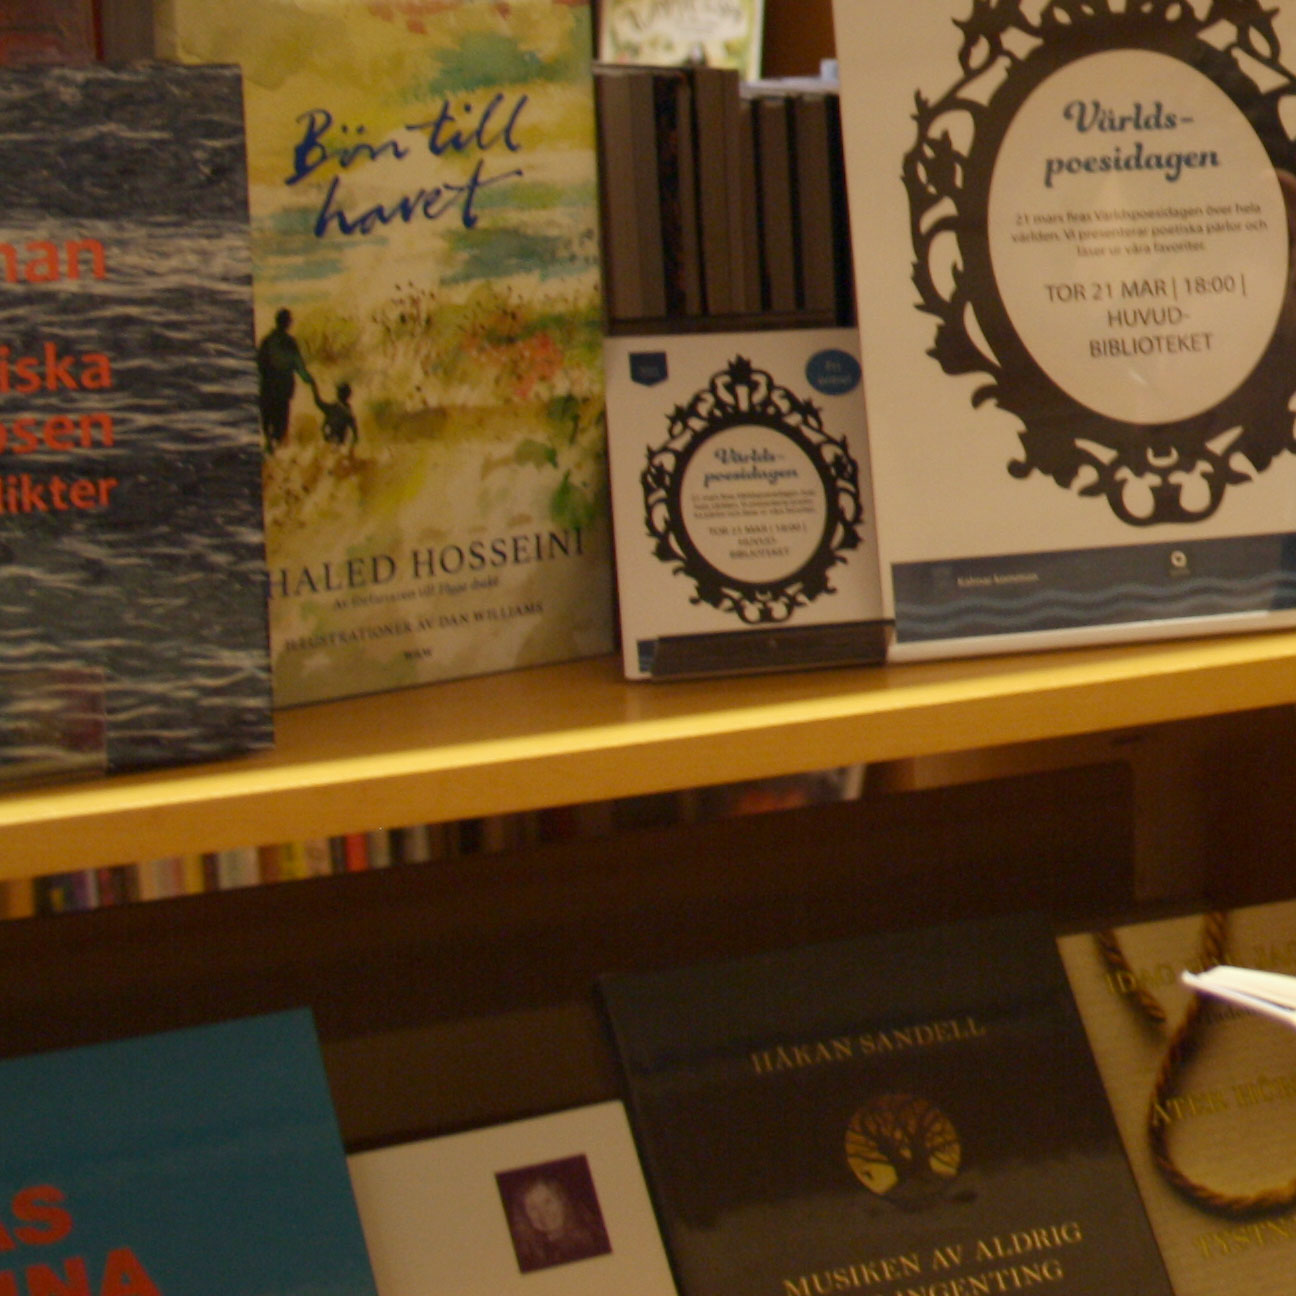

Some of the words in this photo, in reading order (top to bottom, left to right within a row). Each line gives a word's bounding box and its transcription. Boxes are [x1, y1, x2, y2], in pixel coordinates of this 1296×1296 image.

[1063, 100, 1194, 134] Världs-
[285, 109, 409, 186] Bön
[405, 93, 528, 155] till
[1044, 141, 1219, 189] poesidagen
[314, 158, 523, 237] havet
[1044, 282, 1087, 304] TOR
[1091, 280, 1113, 301] 21
[1121, 278, 1168, 301] MAR
[1184, 275, 1236, 298] 18:00
[1107, 306, 1191, 329] HUVUD-
[1089, 332, 1214, 359] BIBLIOTEKET
[0, 412, 115, 454] sen
[0, 474, 118, 515] ikter
[268, 554, 395, 598] HALED
[413, 527, 585, 579] HOSSEINI
[438, 611, 470, 630] DAN
[858, 1016, 986, 1055] SANDELL
[782, 1252, 922, 1296] MUSIKEN
[931, 1244, 963, 1271] AV
[975, 1221, 1083, 1262] ALDRIG
